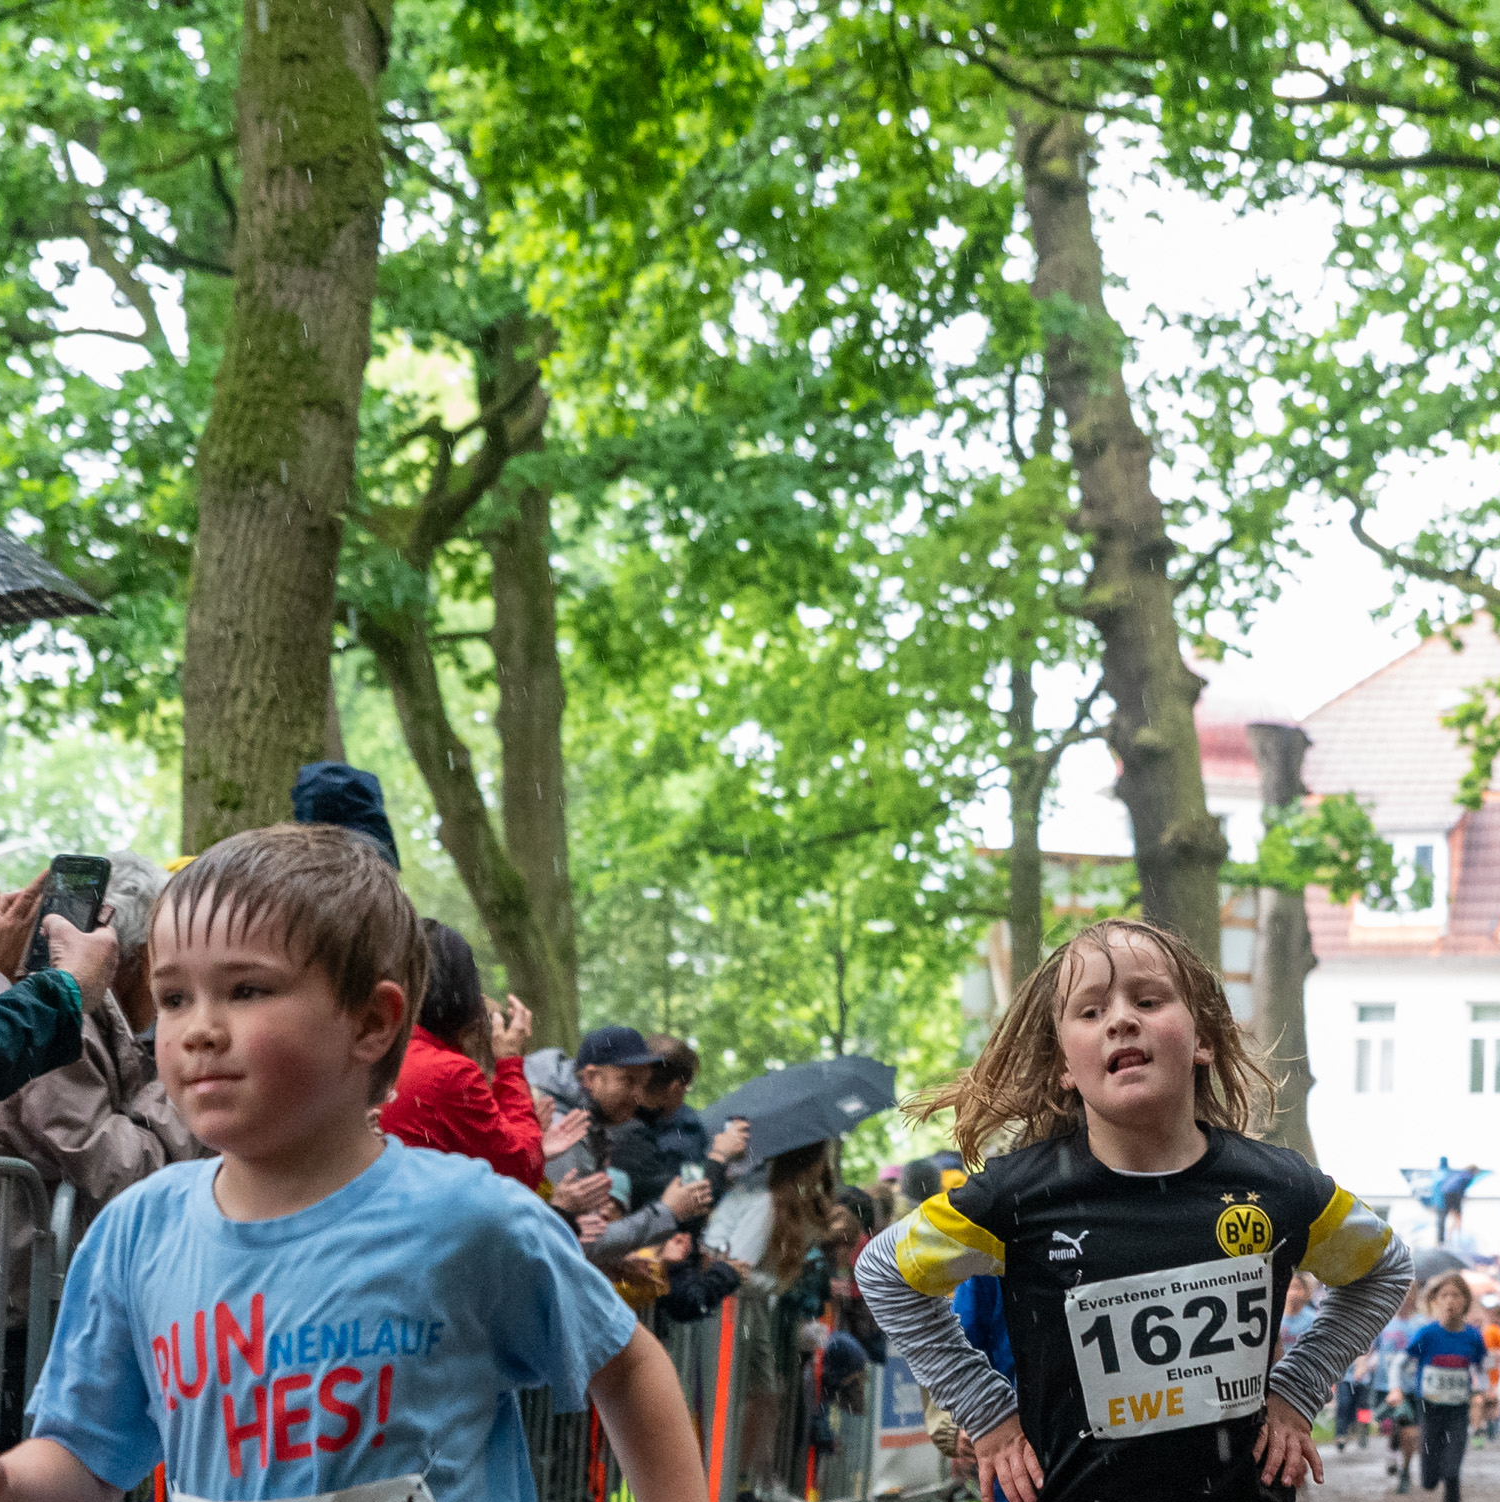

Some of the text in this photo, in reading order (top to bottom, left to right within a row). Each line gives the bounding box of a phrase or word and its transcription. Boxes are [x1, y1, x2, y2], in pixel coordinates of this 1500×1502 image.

[1225, 1211, 1265, 1244] BVB
[1048, 1248, 1077, 1261] PUMA
[1078, 1267, 1264, 1312] Everstener Brunnenlauf
[1080, 1286, 1269, 1375] 1625
[1166, 1364, 1213, 1381] Elena
[222, 1364, 394, 1478] HES!
[1108, 1387, 1184, 1426] EWE
